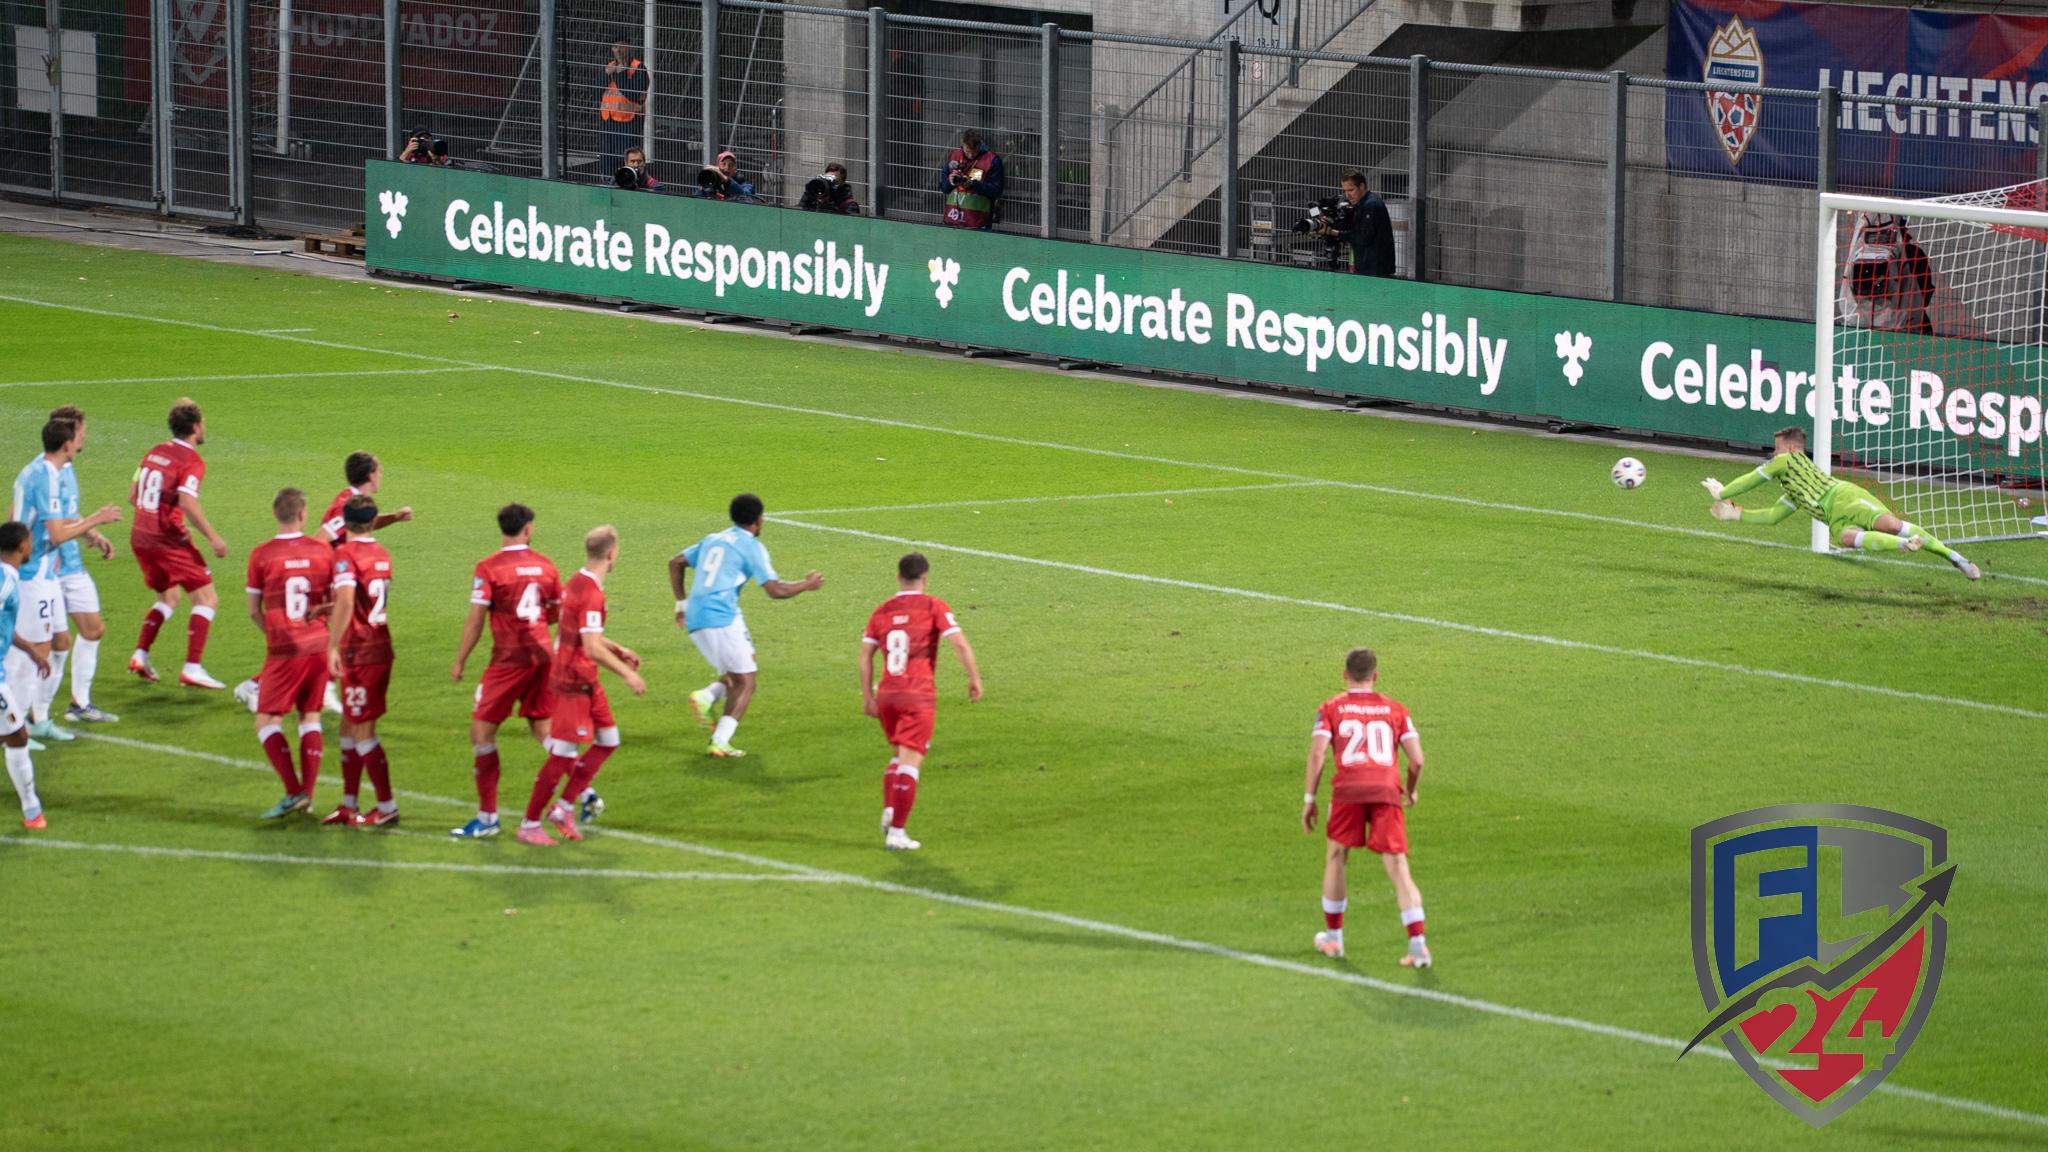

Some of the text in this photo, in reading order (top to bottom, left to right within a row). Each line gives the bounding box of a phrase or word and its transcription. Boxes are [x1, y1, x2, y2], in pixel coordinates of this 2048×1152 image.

[444, 199, 889, 317] Celebrate Responsibly
[1003, 267, 1508, 396] Celebrate Responsibly
[1910, 369, 2048, 457] Resp
[137, 467, 163, 513] 18
[703, 545, 725, 588] 9
[285, 575, 311, 622] 6
[516, 582, 542, 625] 4
[886, 629, 909, 676] 8
[345, 686, 368, 707] 23
[1338, 718, 1394, 767] 20
